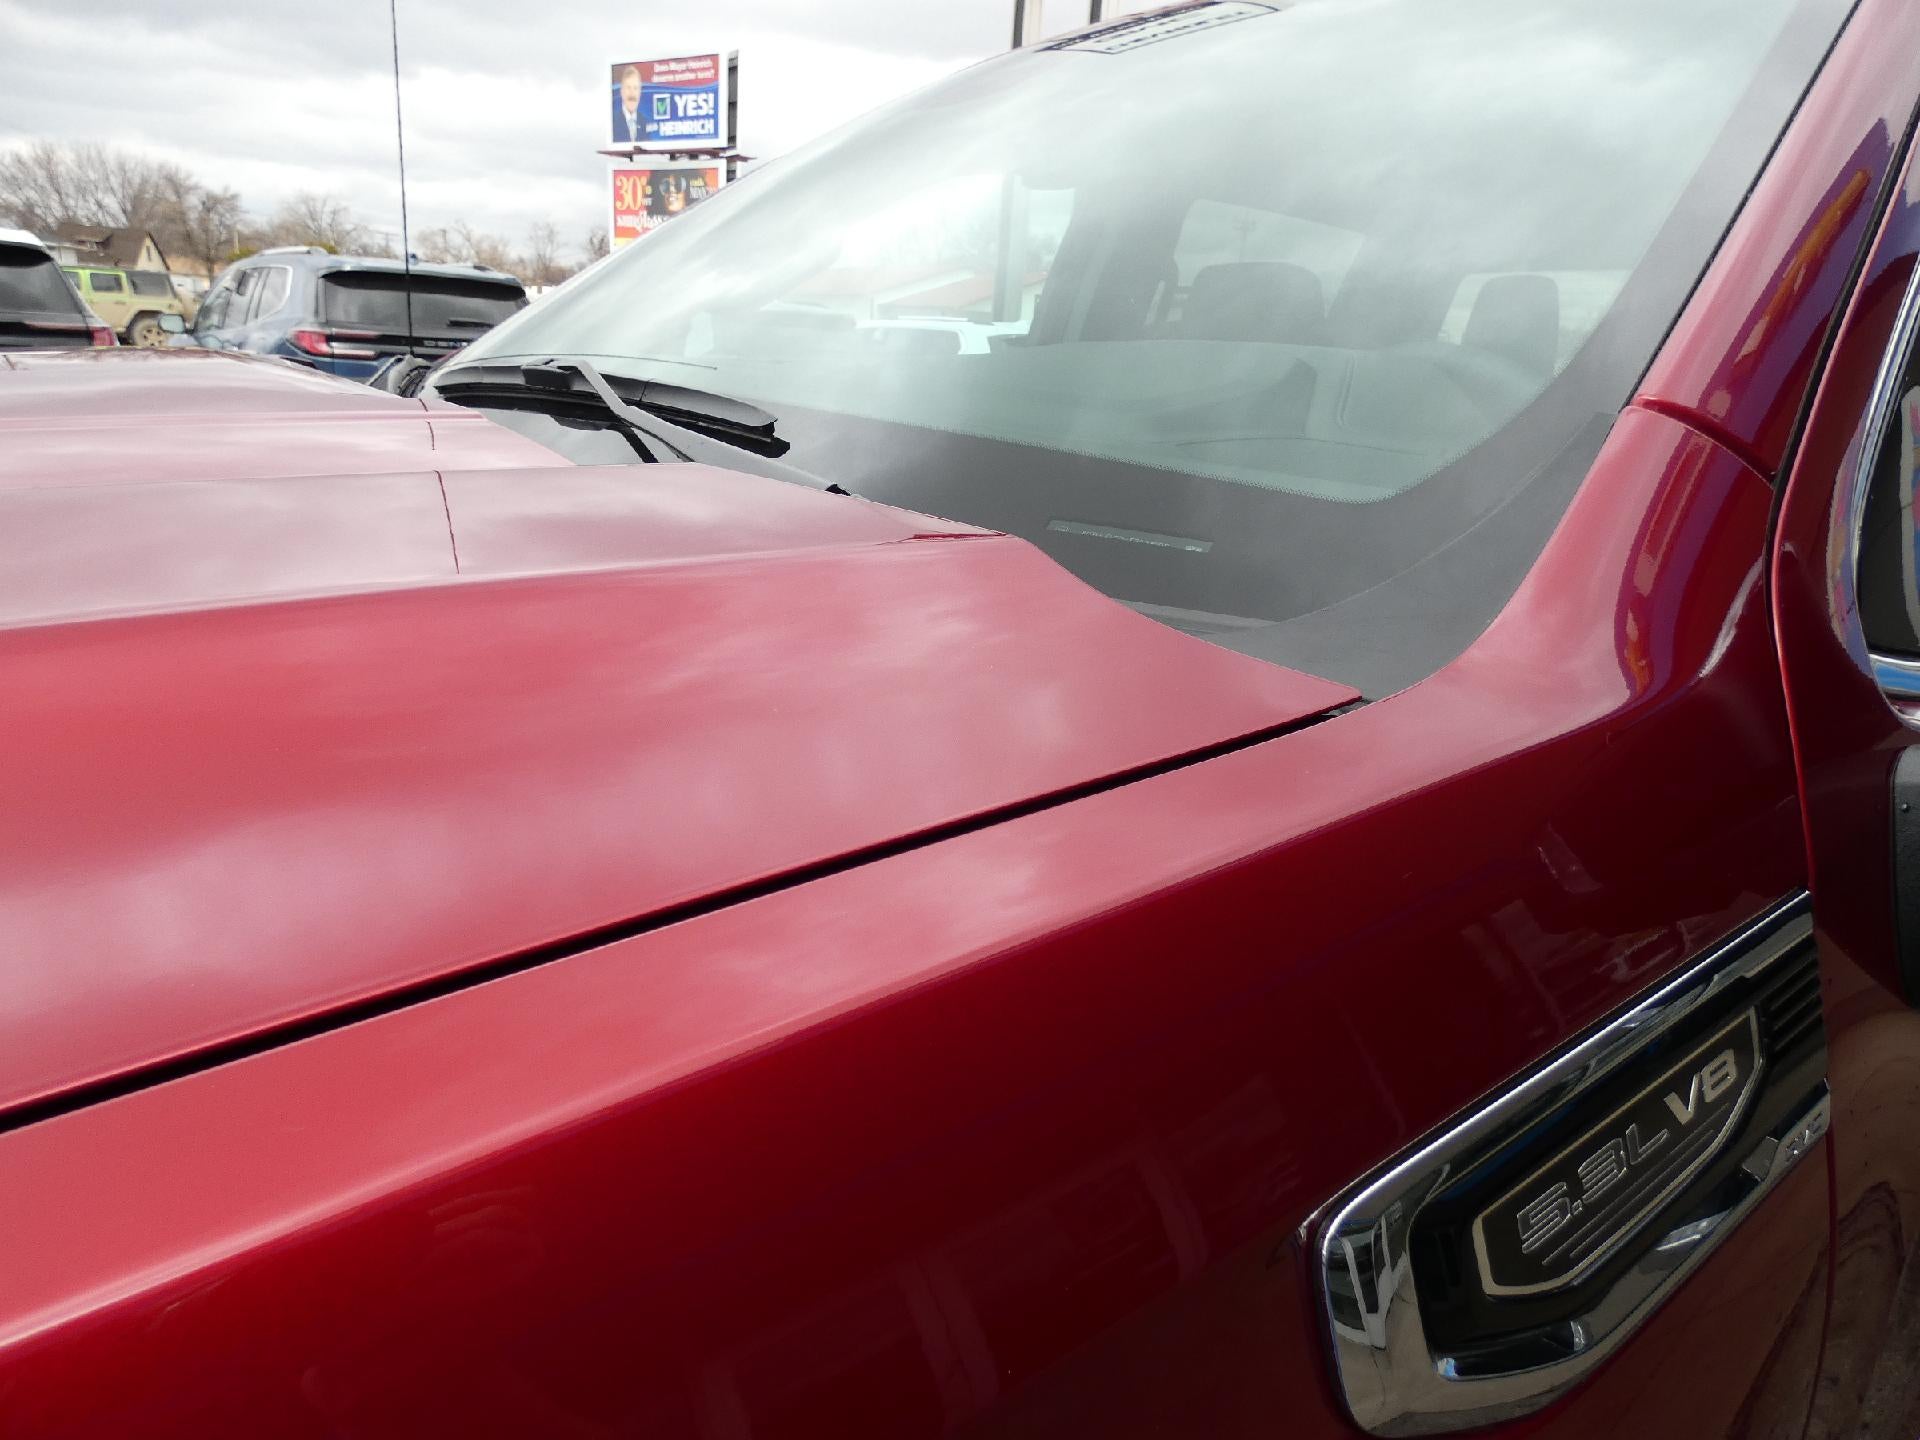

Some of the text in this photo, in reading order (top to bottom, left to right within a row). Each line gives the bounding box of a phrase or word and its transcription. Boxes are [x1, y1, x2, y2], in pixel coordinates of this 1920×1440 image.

[674, 93, 715, 117] YES!
[659, 118, 715, 136] HEINRICH
[1516, 1049, 1738, 1254] 5.3L V8
